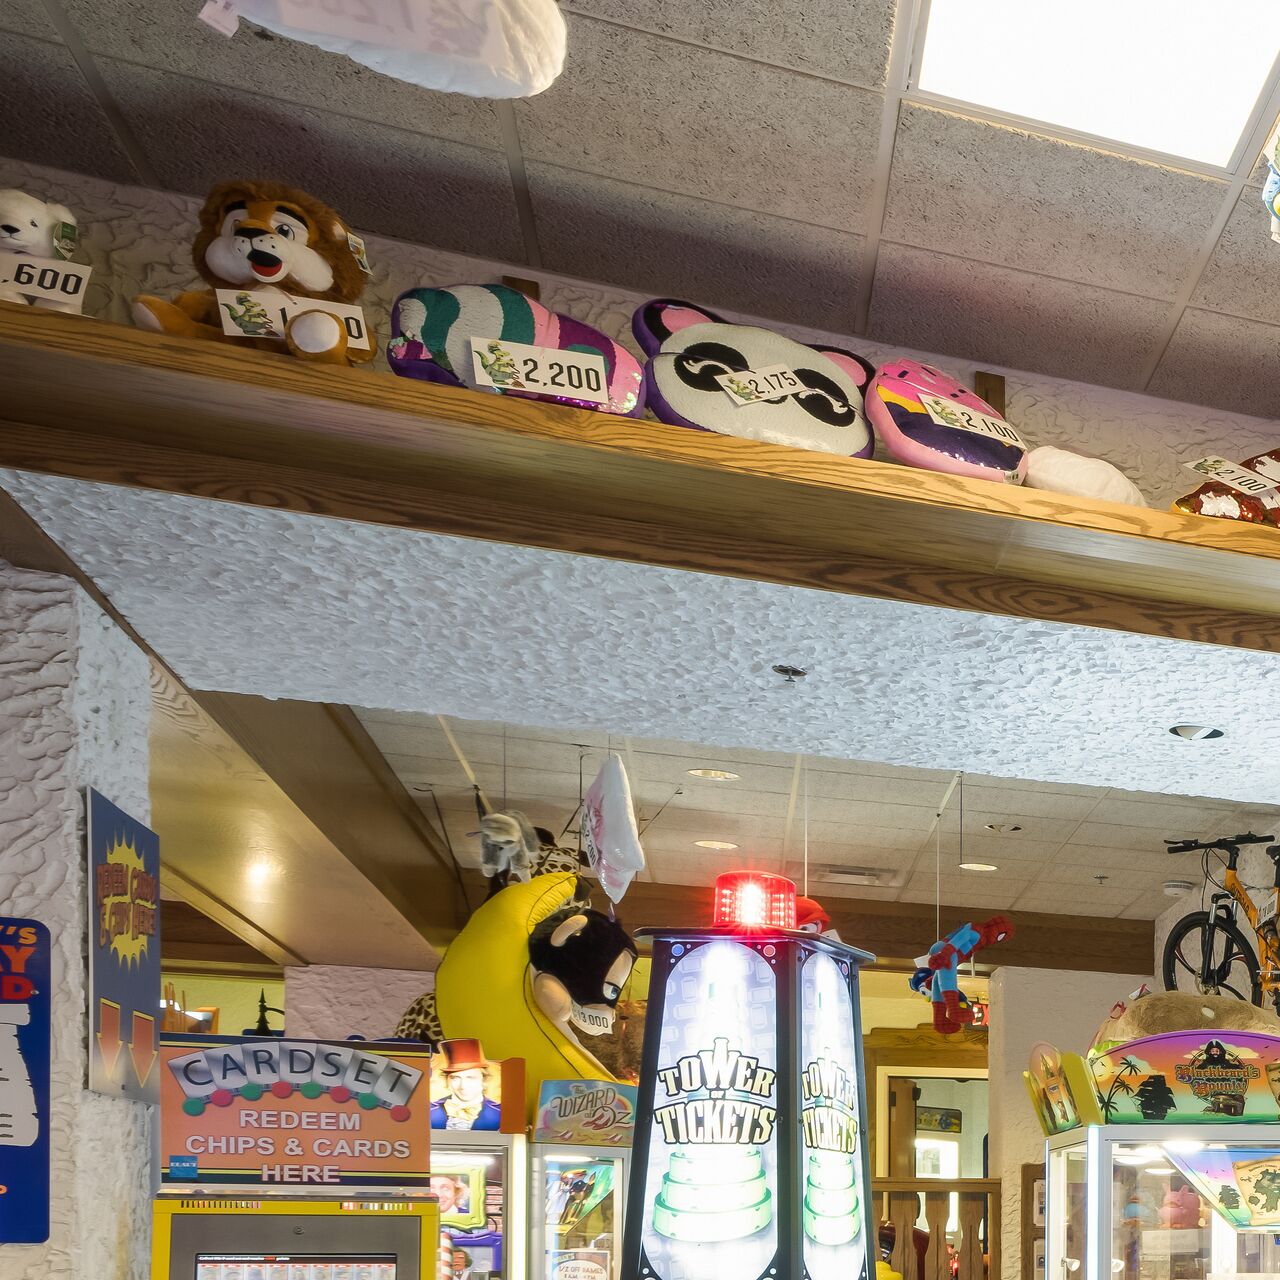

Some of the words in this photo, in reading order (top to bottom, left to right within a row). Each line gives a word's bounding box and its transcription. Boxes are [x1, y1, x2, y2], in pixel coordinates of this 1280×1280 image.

[523, 357, 602, 393] 2,200
[748, 371, 798, 396] 2,175
[960, 411, 1020, 444] 2,100
[1216, 469, 1268, 493] 2,100
[182, 1048, 412, 1094] CARDSET
[657, 1046, 777, 1098] TOWER
[802, 1055, 856, 1110] TOWER
[1176, 1064, 1260, 1082] Blackbeard's
[552, 1088, 616, 1119] WIZARD
[1194, 1080, 1249, 1097] Bounty
[239, 1109, 361, 1130] REDEEM
[654, 1098, 778, 1145] TICKETS
[802, 1104, 859, 1154] TICKETS
[185, 1135, 275, 1155] CHIPS
[284, 1138, 304, 1156] &
[312, 1138, 410, 1158] CARDS
[261, 1164, 341, 1183] HERE
